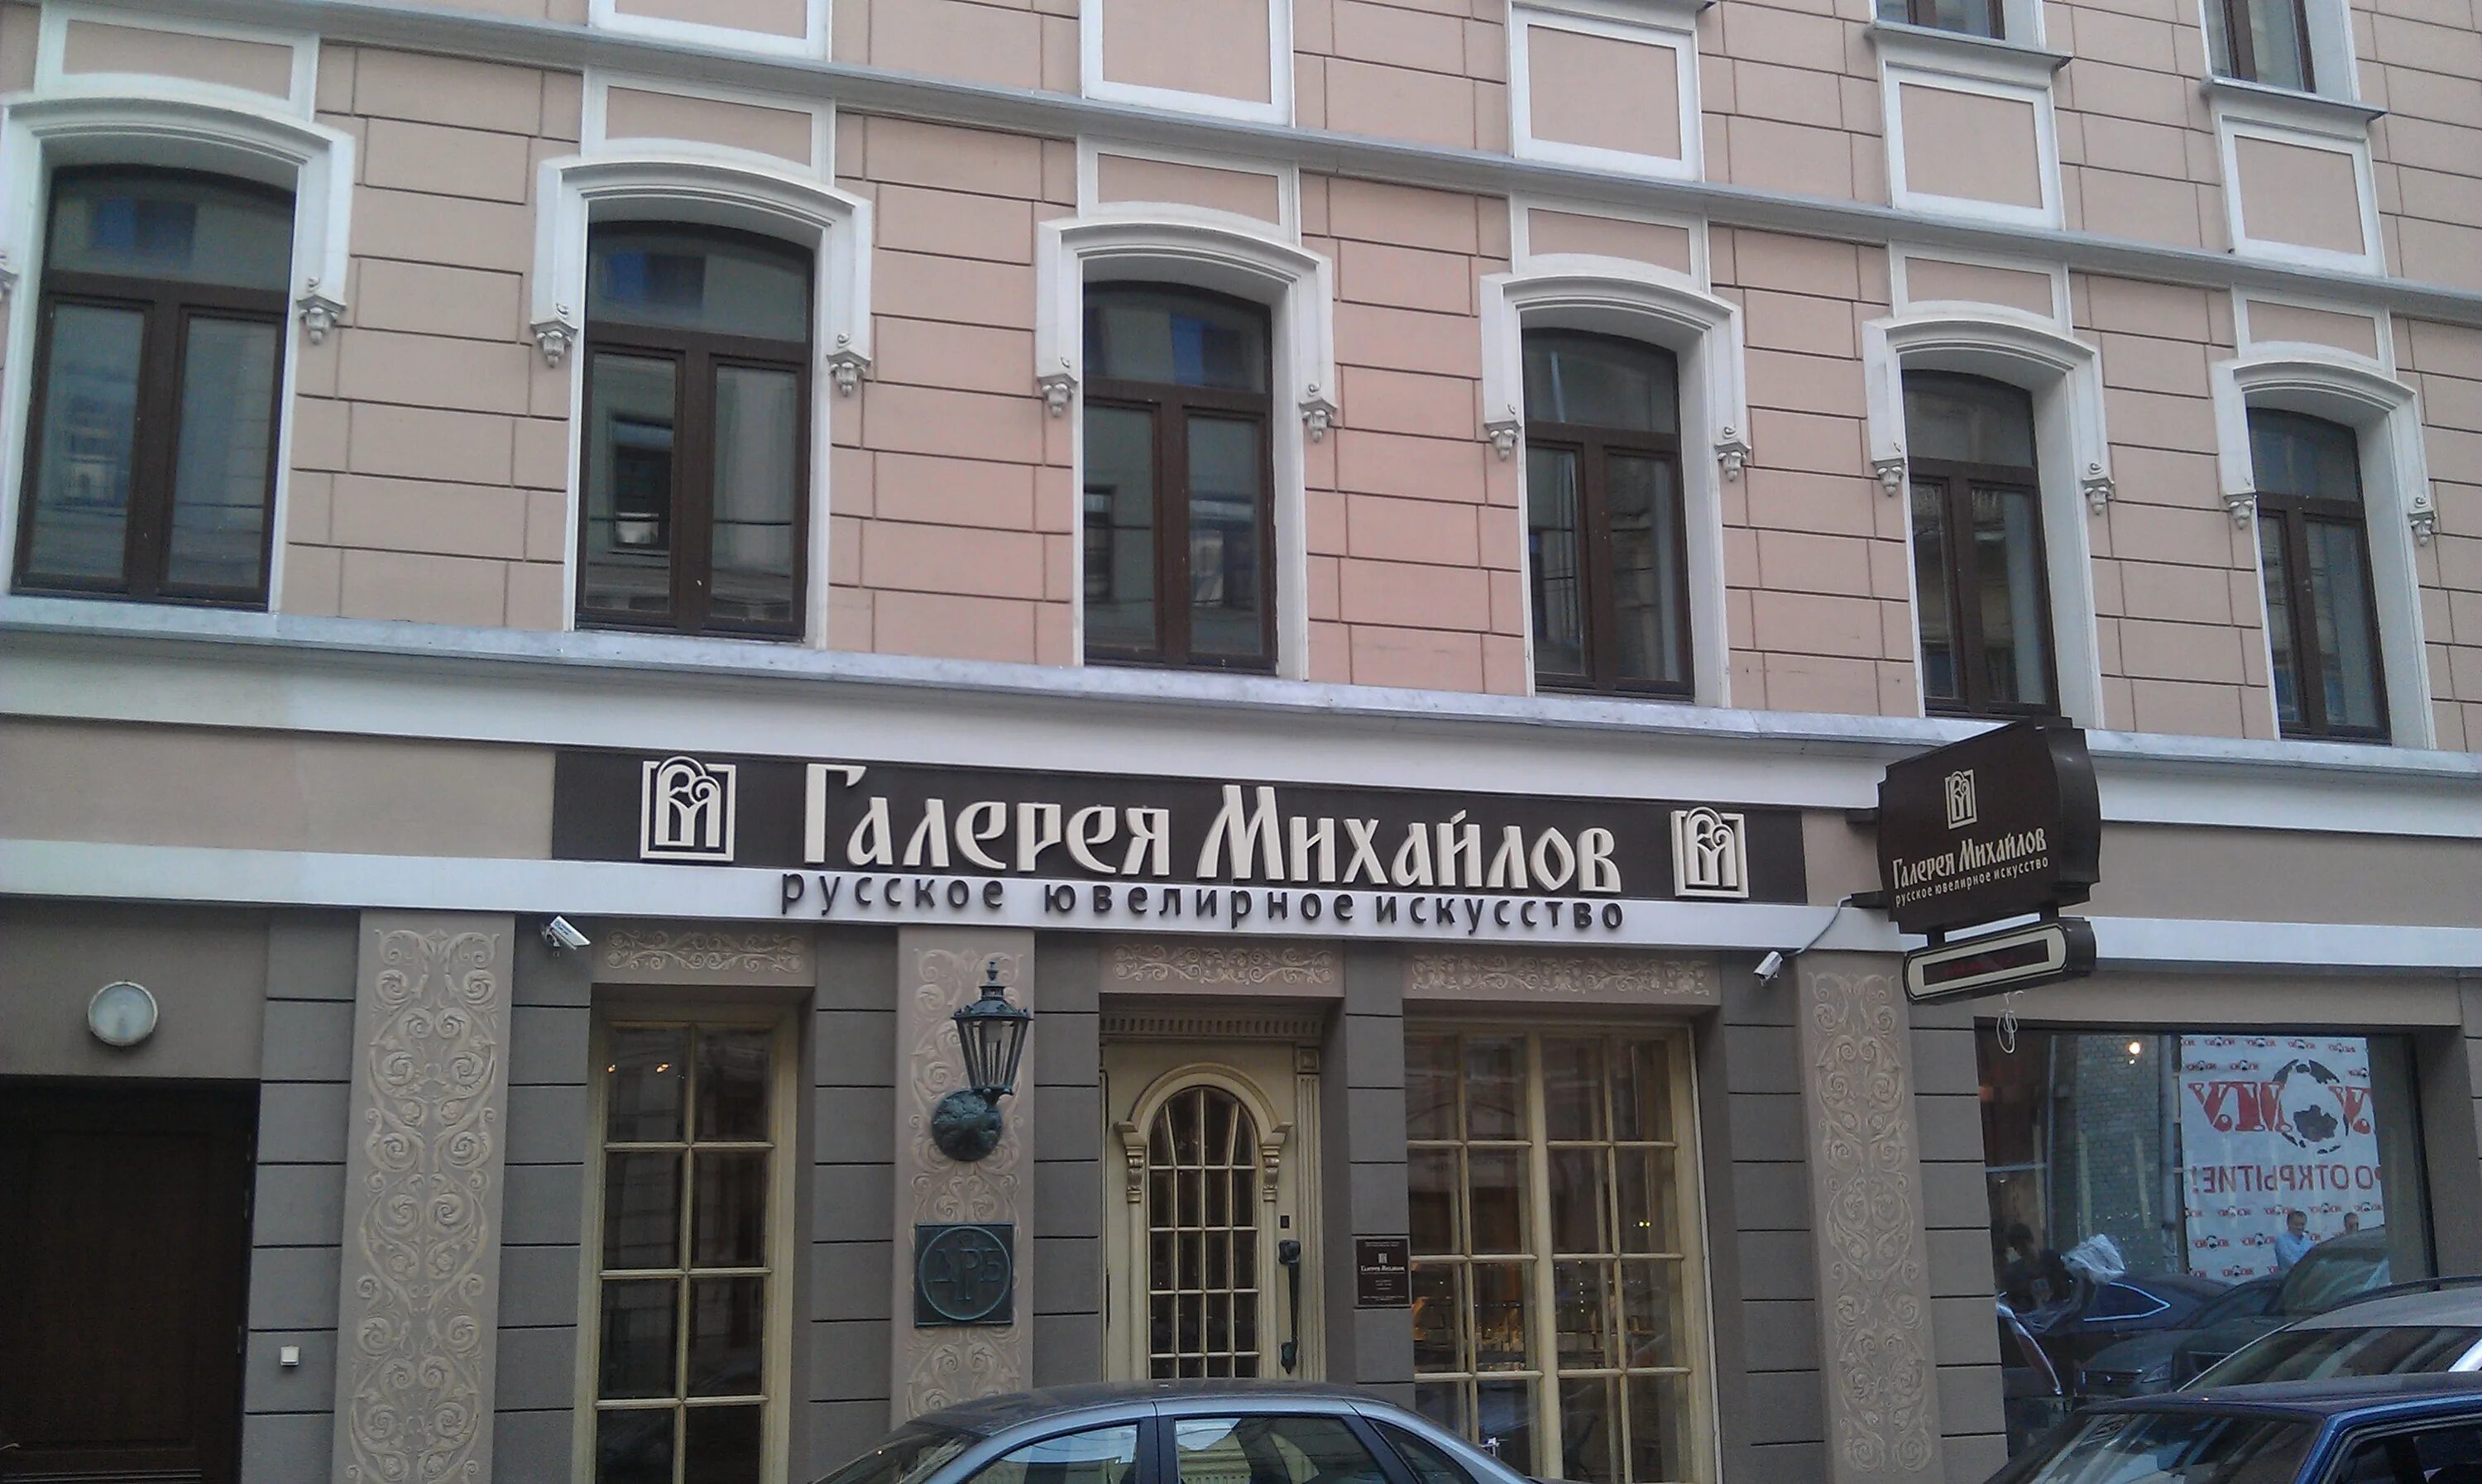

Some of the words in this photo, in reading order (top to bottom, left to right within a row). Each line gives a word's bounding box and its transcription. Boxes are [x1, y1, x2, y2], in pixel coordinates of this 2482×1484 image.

[803, 762, 1171, 877] Галерея
[1196, 784, 1622, 893] Михайлов
[1892, 852, 1956, 890] Галерея
[1958, 827, 2048, 873] Михайлов
[781, 873, 1004, 917] русское
[1044, 883, 1354, 930] ювелирное
[1374, 894, 1624, 936] искусство
[1895, 886, 1933, 908] русское
[1934, 872, 1992, 895] ювелирное
[1993, 856, 2049, 879] искусство
